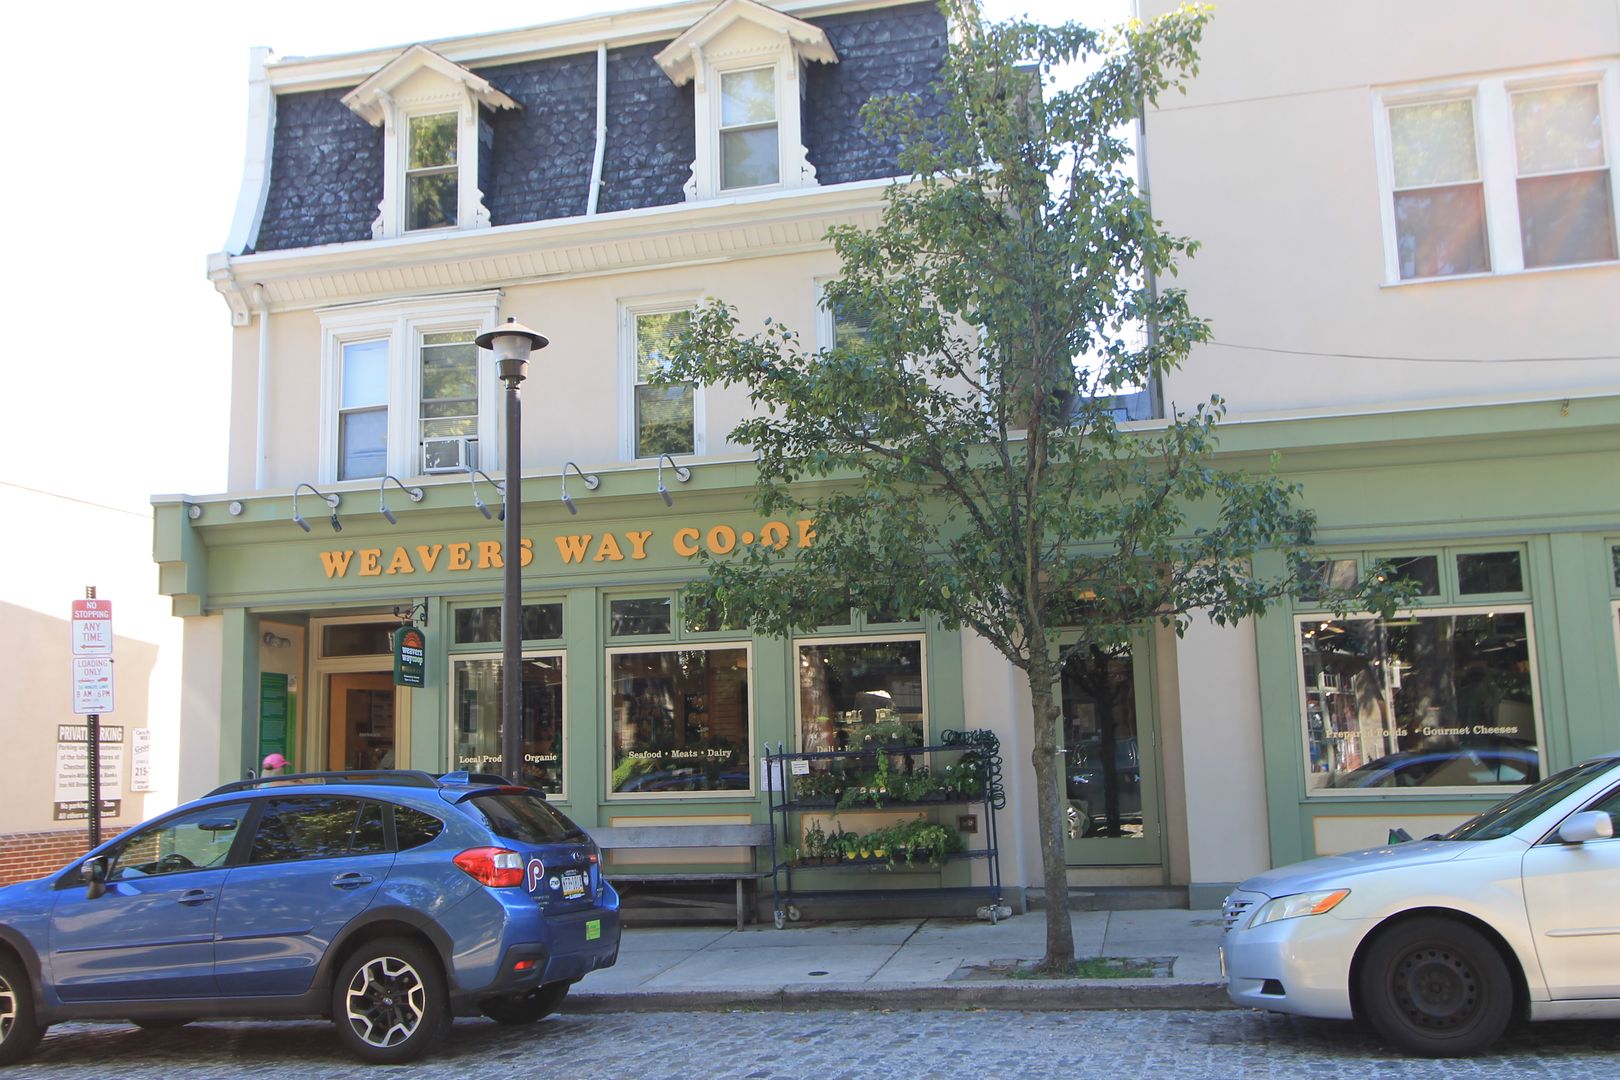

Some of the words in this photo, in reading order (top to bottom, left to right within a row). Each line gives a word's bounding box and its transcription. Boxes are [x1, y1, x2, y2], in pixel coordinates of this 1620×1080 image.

[320, 538, 534, 578] WEAVERS
[554, 530, 653, 564] WAY
[86, 601, 97, 609] NO
[74, 610, 109, 619] STOPPING
[83, 622, 102, 631] ANY
[82, 632, 103, 641] TIME
[77, 660, 108, 668] LOADING
[83, 668, 102, 676] ONLY
[100, 727, 123, 741] RKING
[1326, 729, 1371, 740] Prepard
[1376, 728, 1408, 737] Fods
[1423, 725, 1469, 736] Gourmet
[1472, 724, 1518, 735] Cheeses
[459, 755, 481, 763] Local
[482, 754, 502, 763] Prod
[524, 753, 557, 763] Organic
[628, 750, 661, 759] Seafood
[671, 750, 698, 758] Meats
[707, 749, 731, 759] Dairy
